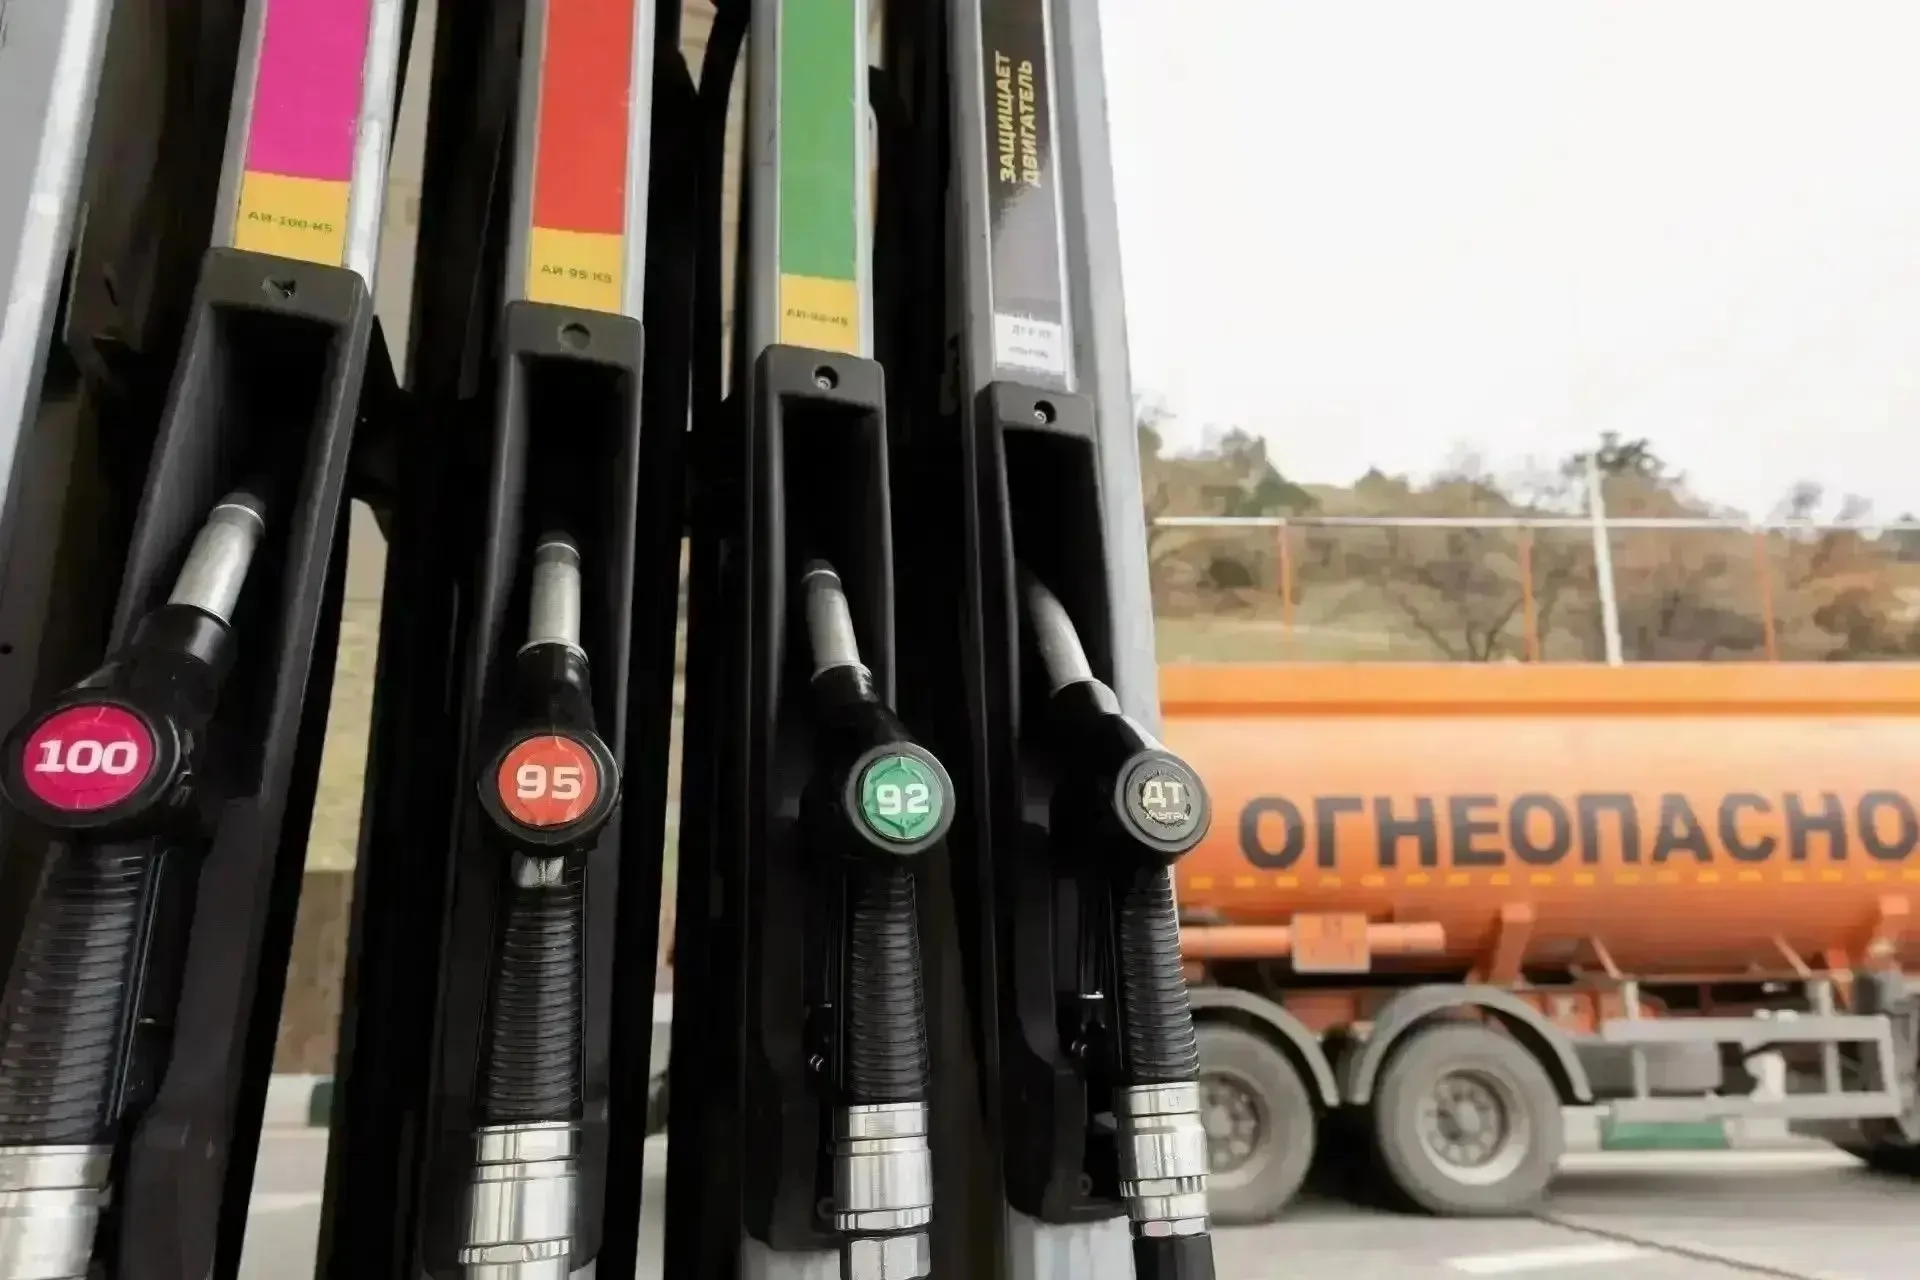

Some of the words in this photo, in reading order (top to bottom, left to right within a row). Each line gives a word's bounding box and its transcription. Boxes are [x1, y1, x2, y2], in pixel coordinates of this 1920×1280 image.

[995, 50, 1016, 184] ЗАЩИЩАЕТ
[1018, 60, 1041, 188] ДВИГАТЕЛЬ
[34, 739, 138, 775] 100
[516, 764, 581, 800] 95
[876, 783, 929, 815] 92
[1142, 781, 1183, 808] ДТ
[1238, 790, 1919, 870] ОГНЕОПАСНО
